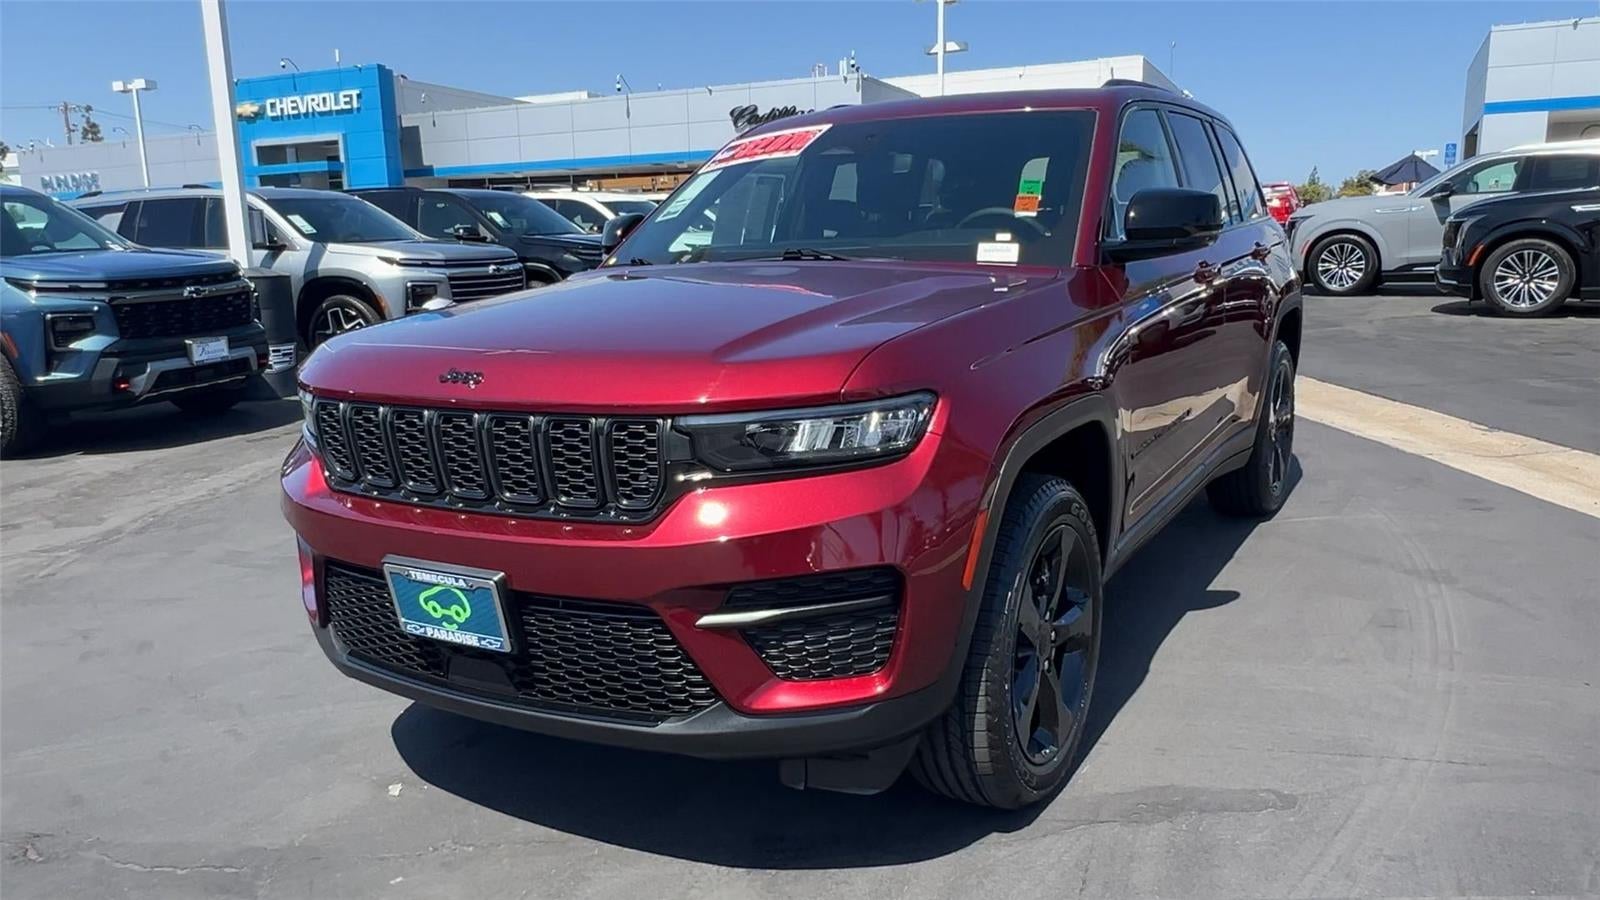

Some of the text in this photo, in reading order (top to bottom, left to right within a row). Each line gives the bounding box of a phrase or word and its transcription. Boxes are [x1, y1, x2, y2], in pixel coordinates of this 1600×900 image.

[265, 89, 361, 118] CHEVROLET
[408, 570, 468, 588] TEMECULA
[425, 626, 481, 647] PARADISE
